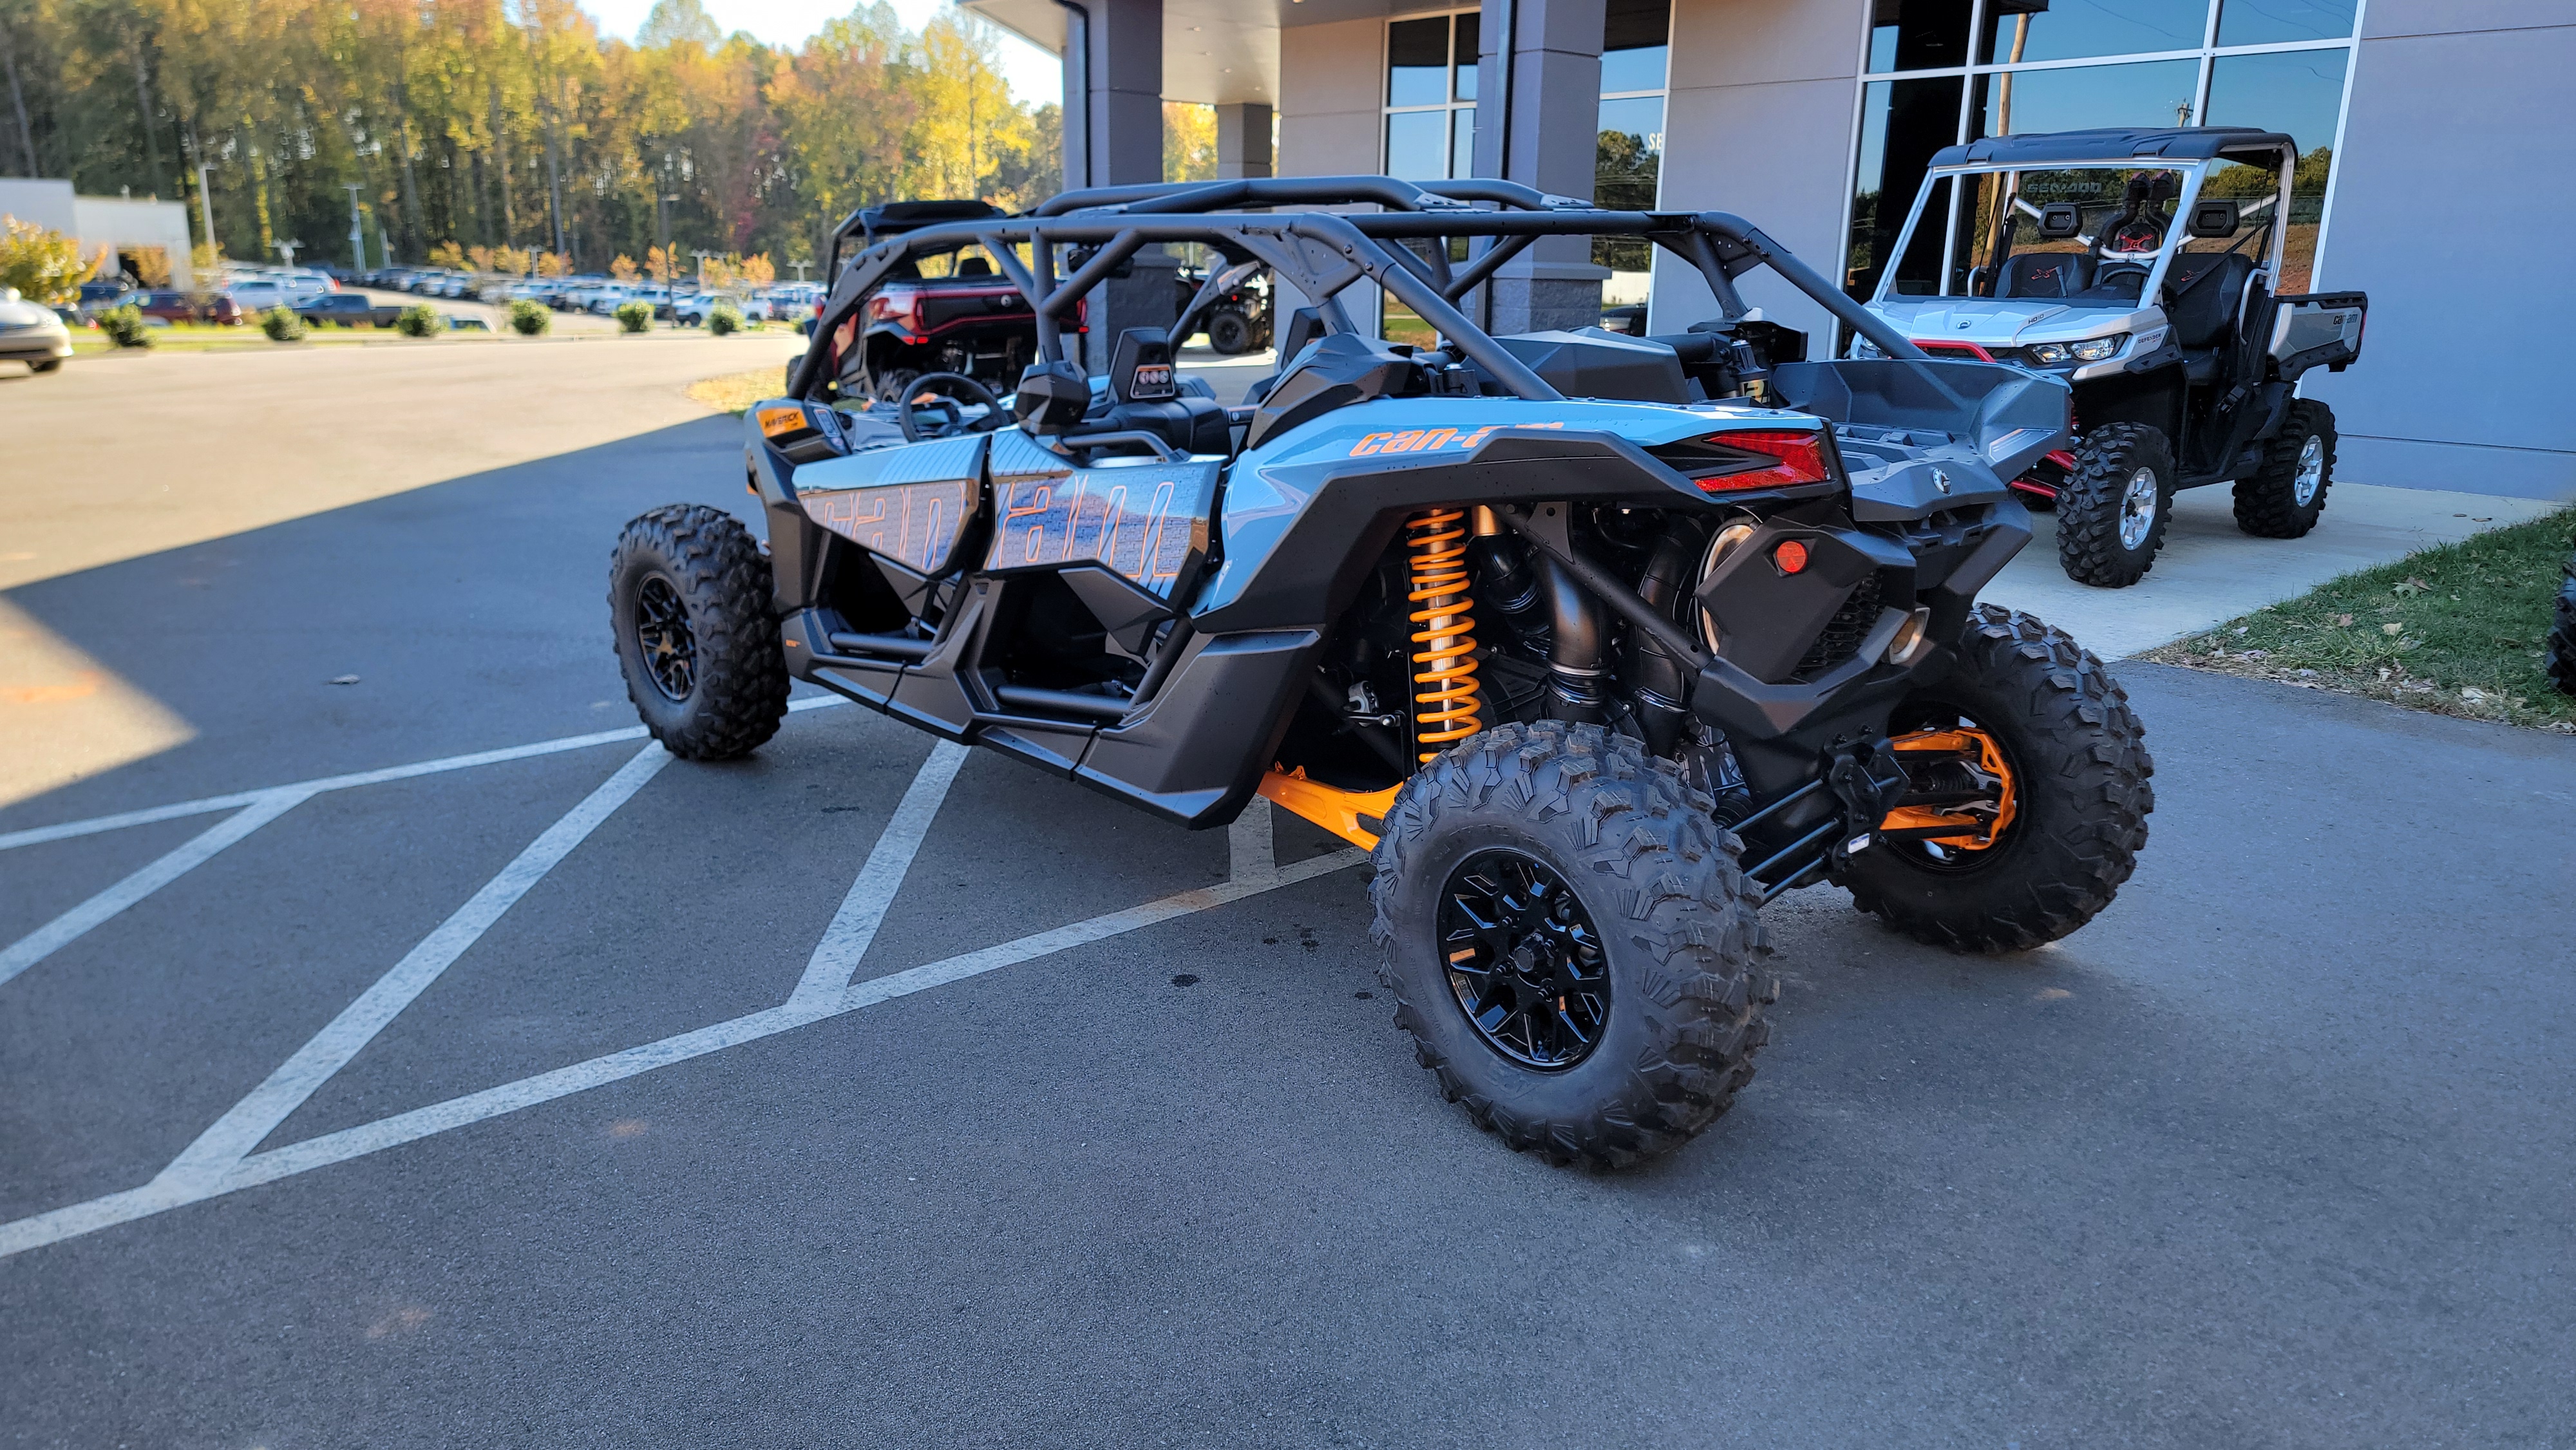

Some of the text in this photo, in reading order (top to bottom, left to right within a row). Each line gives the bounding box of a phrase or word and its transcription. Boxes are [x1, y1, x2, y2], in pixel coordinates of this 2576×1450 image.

[2028, 314, 2044, 325] HD10
[2138, 333, 2161, 344] DEFENDER
[764, 411, 799, 428] MAVERICK
